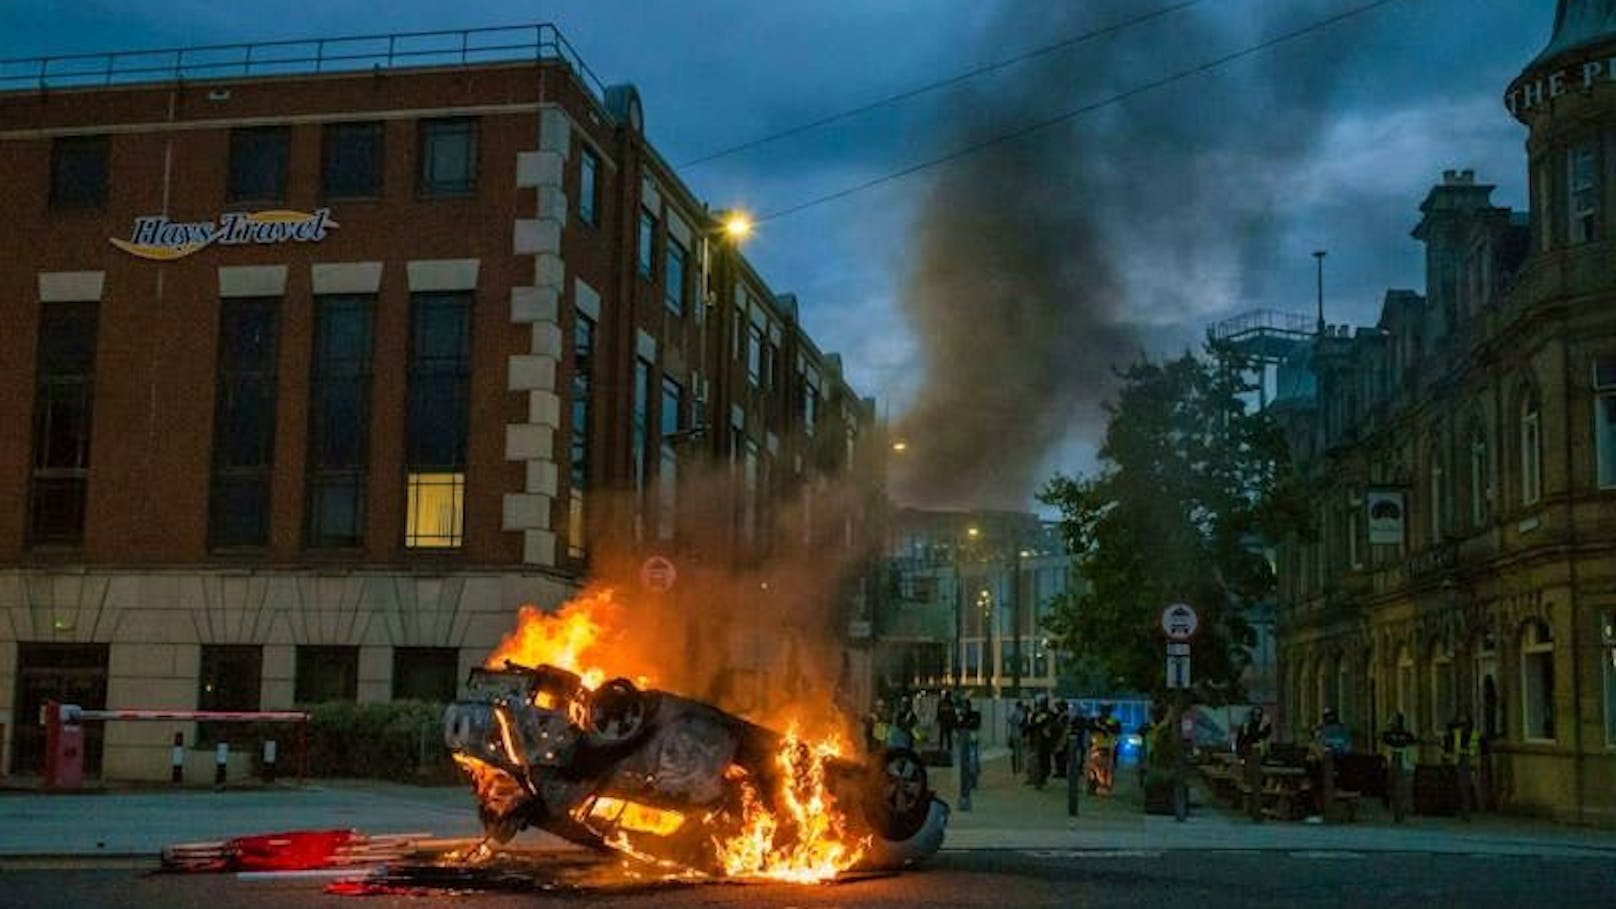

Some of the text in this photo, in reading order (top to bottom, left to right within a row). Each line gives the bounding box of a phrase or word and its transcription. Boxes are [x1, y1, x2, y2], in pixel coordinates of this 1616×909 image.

[1509, 70, 1566, 112] THE
[132, 208, 328, 251] Hays Travel
